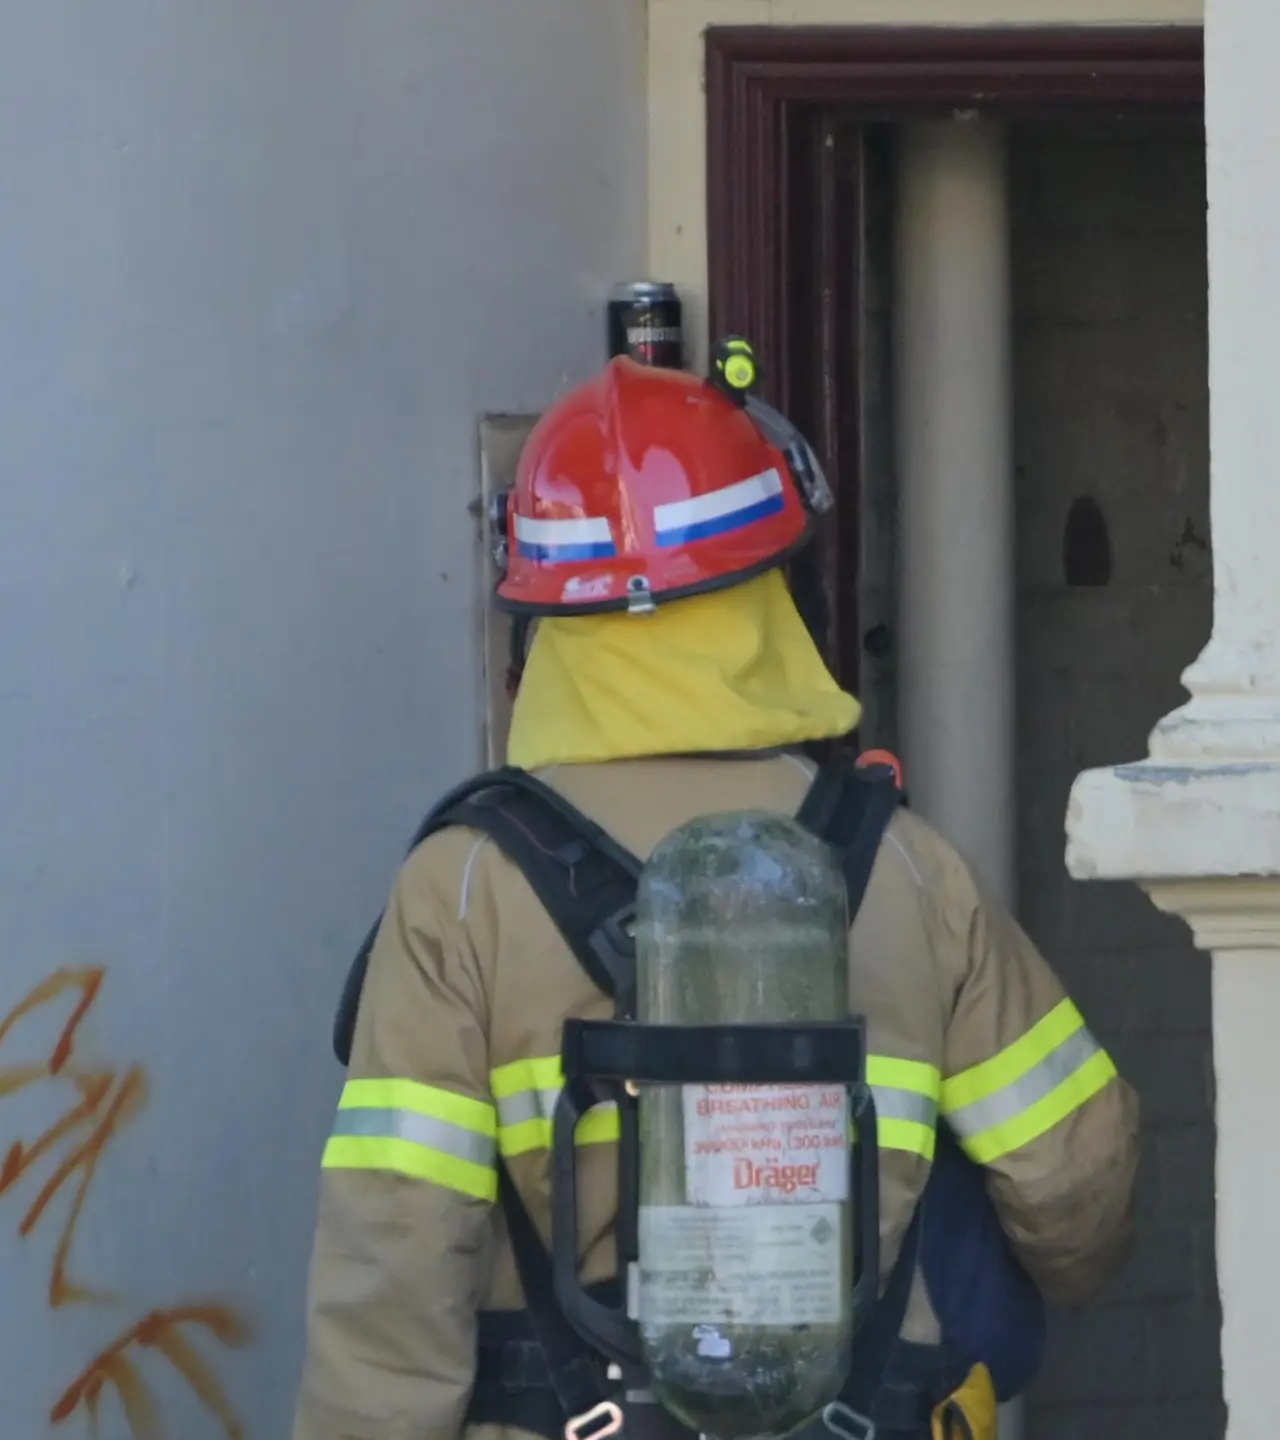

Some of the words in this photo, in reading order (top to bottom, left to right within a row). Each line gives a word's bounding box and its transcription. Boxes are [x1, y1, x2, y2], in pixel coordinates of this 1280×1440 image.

[697, 1094, 810, 1117] BREATHING
[819, 1092, 842, 1109] AIR
[733, 1157, 821, 1194] Dräger
